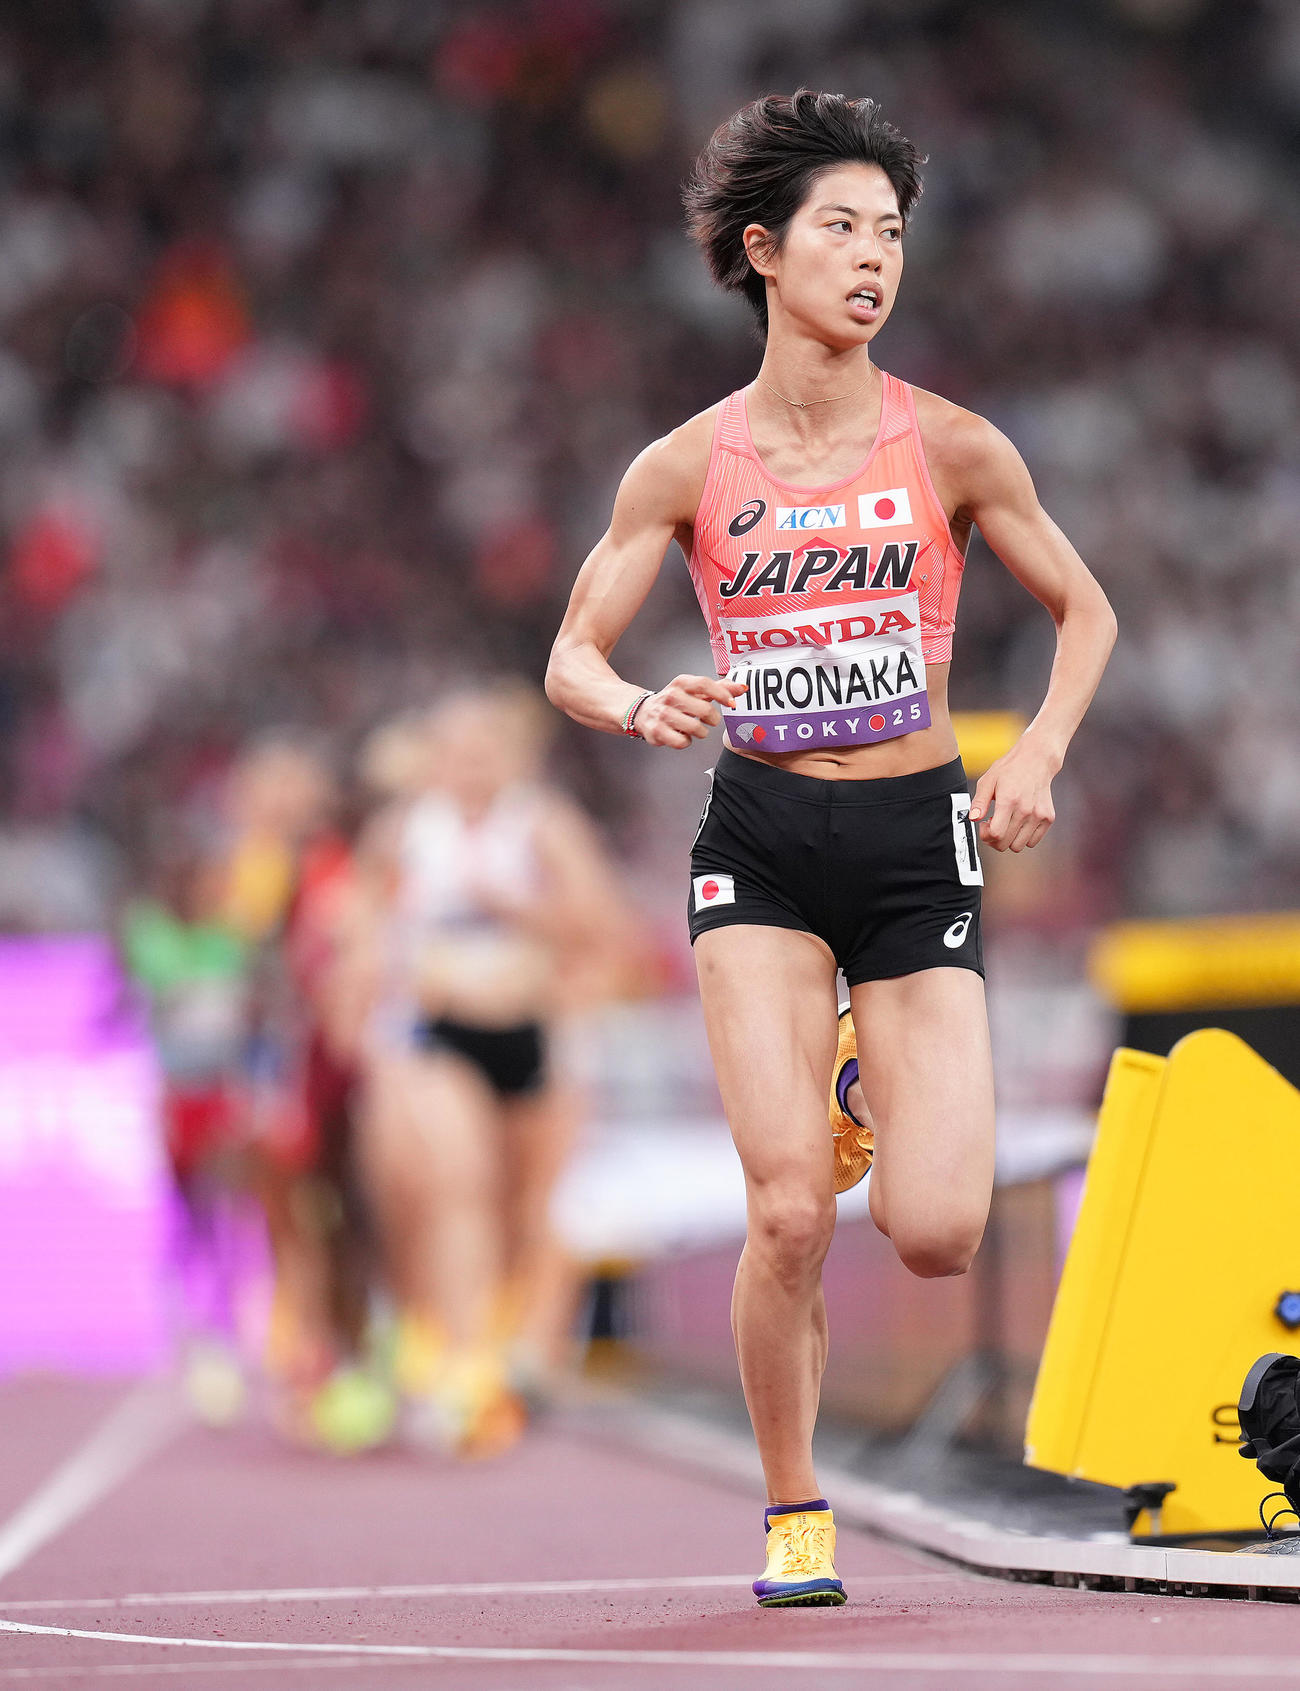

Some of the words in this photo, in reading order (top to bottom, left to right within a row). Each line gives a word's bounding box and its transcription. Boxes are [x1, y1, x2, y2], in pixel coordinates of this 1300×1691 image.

[778, 506, 843, 529] ACN
[719, 541, 919, 599] JAPAN
[726, 610, 916, 654] HONDA
